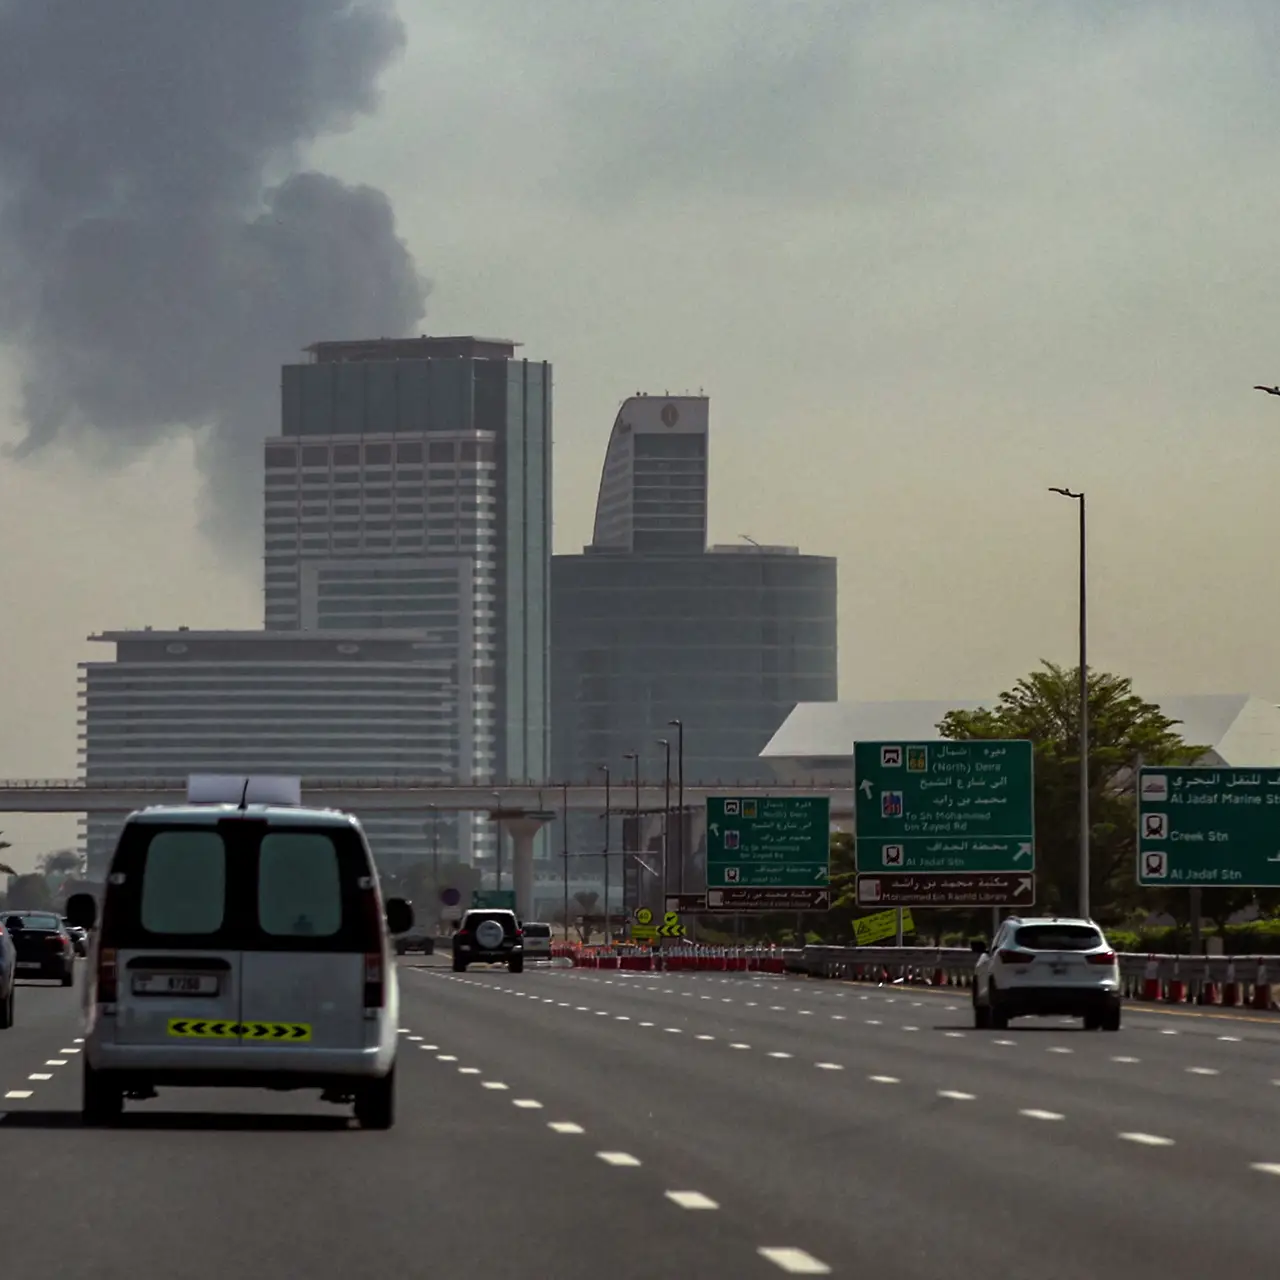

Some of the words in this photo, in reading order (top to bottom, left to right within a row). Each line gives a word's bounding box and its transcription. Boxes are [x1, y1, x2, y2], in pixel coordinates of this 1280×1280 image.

[957, 778, 985, 788] شارع
[1226, 774, 1261, 788] للنقل
[1170, 794, 1183, 804] Al
[1186, 794, 1218, 804] Jadaf
[1221, 794, 1262, 804] Marine
[1170, 831, 1204, 842] Creek
[1208, 831, 1228, 842] Stn
[972, 842, 1008, 851] محطة
[906, 858, 917, 866] Al
[920, 858, 946, 866] Jadaf
[1170, 869, 1183, 879] Al
[1186, 869, 1218, 880] Jadaf
[1221, 869, 1242, 880] Stn
[978, 877, 1009, 888] مكتبة
